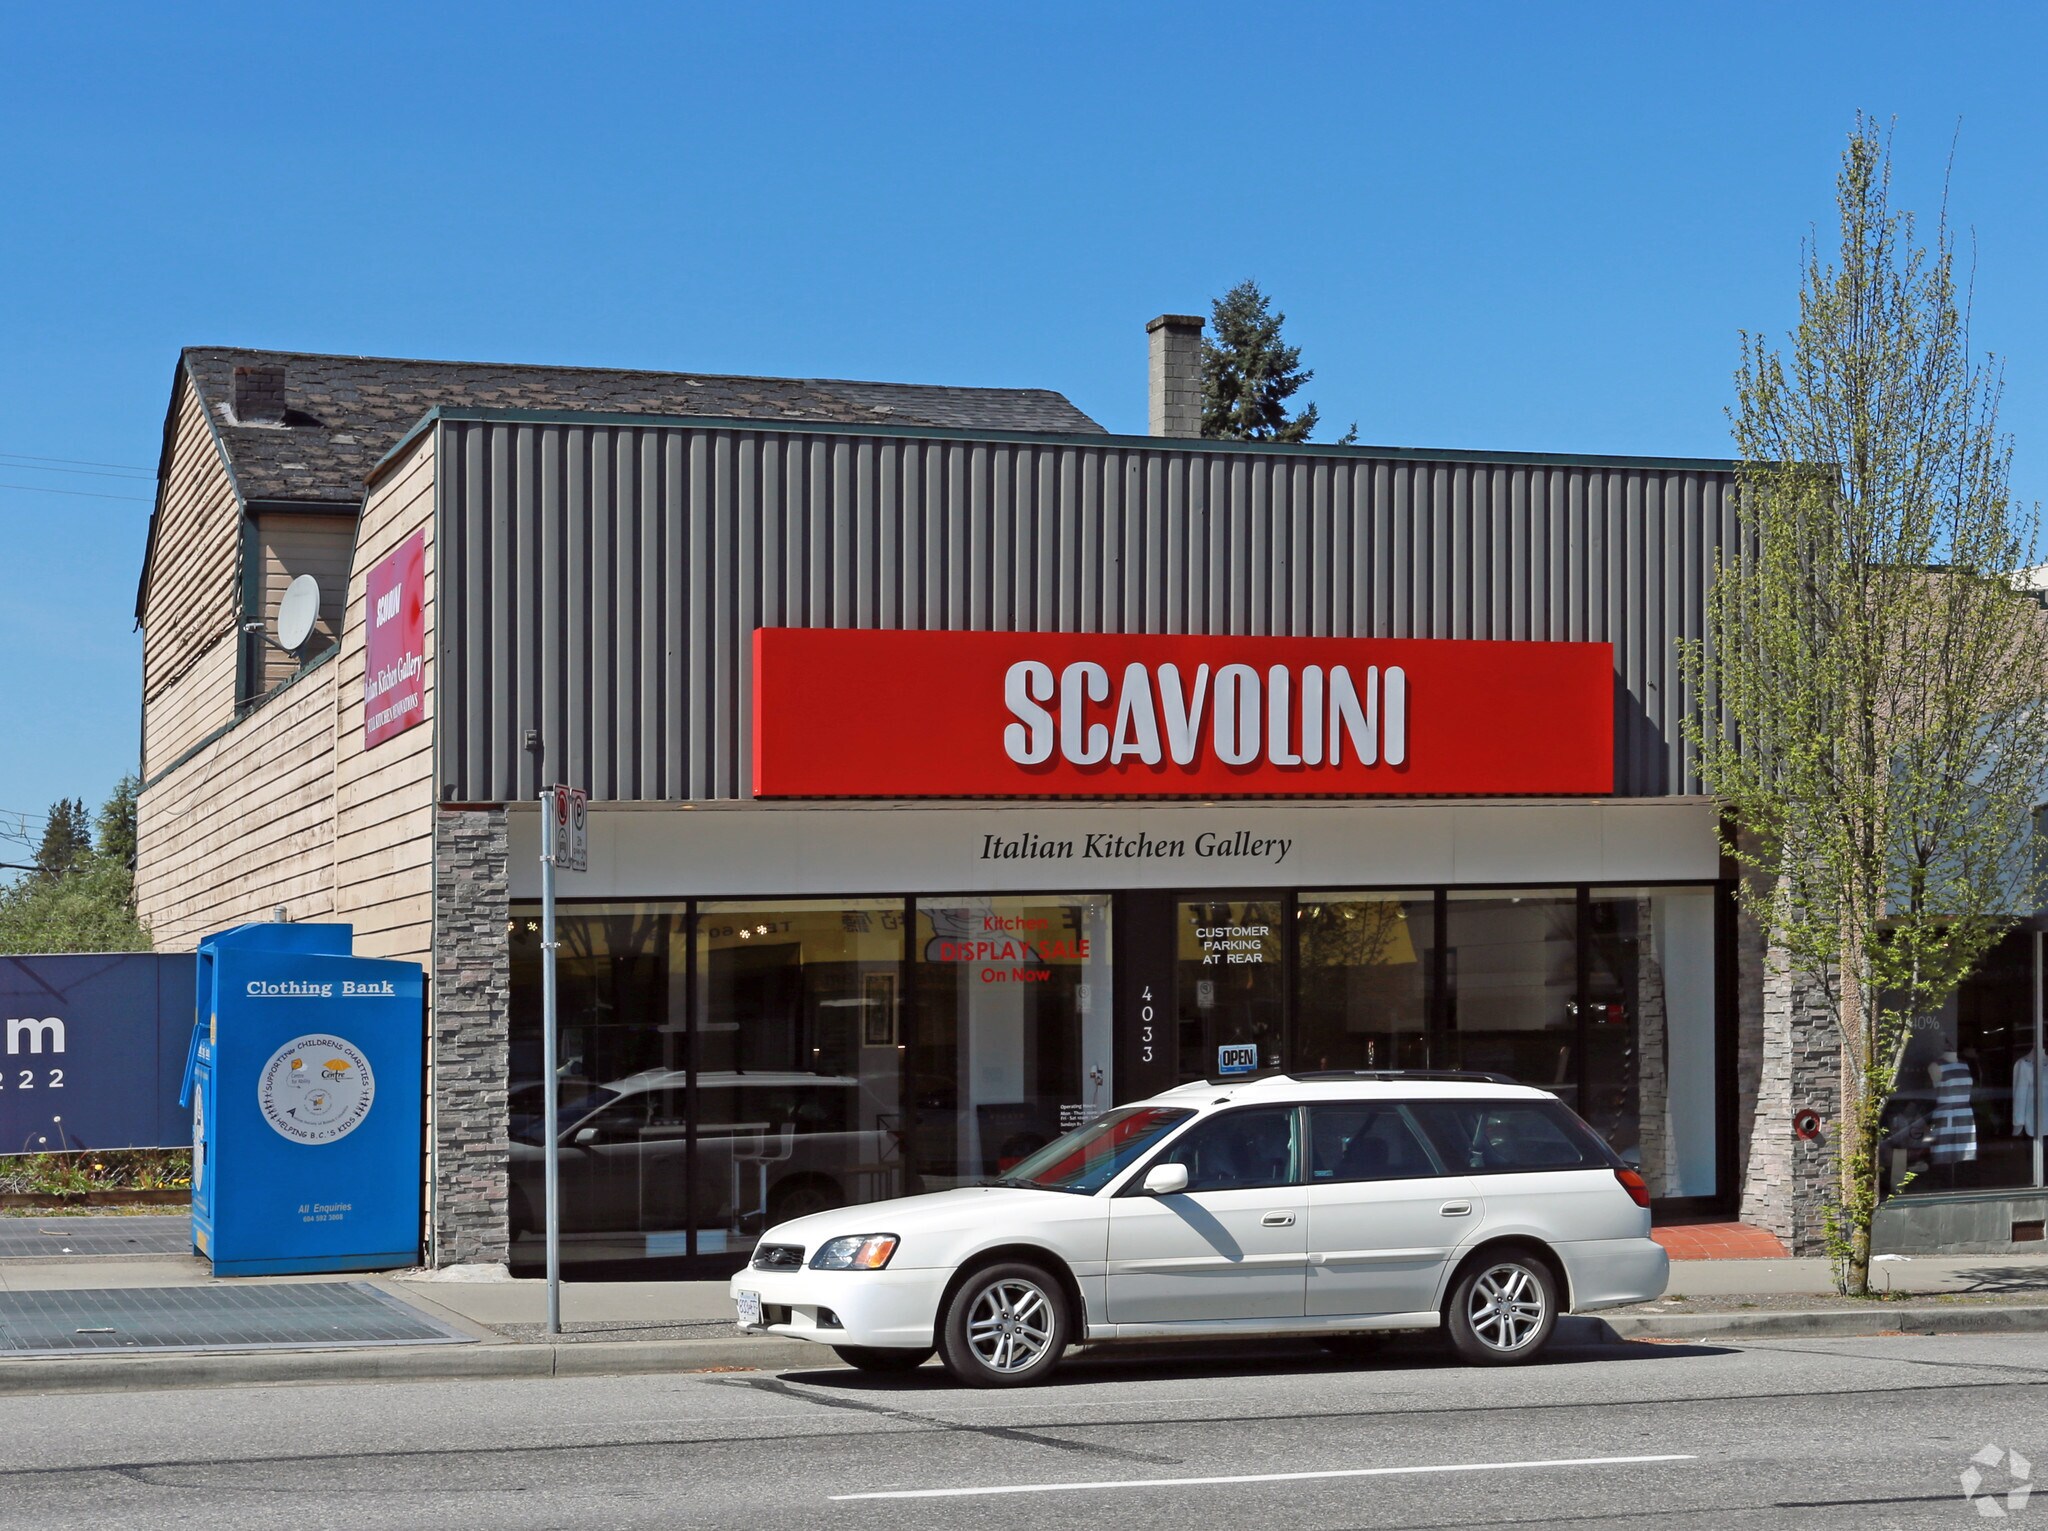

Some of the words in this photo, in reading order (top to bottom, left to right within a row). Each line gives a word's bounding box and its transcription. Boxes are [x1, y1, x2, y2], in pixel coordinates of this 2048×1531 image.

[397, 651, 423, 682] Gallery
[1004, 660, 1406, 766] SCAVOLINI
[981, 832, 1074, 860] Italian
[1082, 831, 1185, 859] Kitchen
[1195, 830, 1293, 865] Gallery
[984, 916, 1049, 931] Kitchen
[1196, 926, 1269, 938] CUSTOMER
[940, 941, 1031, 962] DISPLAY
[1039, 939, 1090, 960] SALE
[1204, 940, 1262, 951] PARKING
[1203, 954, 1221, 965] AT
[1226, 953, 1263, 964] REAR
[981, 968, 1006, 983] On
[1012, 967, 1051, 982] Now
[246, 981, 333, 998] Clothing
[342, 980, 395, 996] Bank
[265, 1048, 296, 1091] SUPPORTING
[297, 1039, 343, 1051] CHILDRENS
[344, 1048, 369, 1087] CHARITIES
[1222, 1048, 1254, 1068] OPEN
[276, 1117, 308, 1138] HELPING
[337, 1117, 356, 1133] KIDS
[297, 1204, 310, 1214] All
[313, 1202, 352, 1214] Enquiries
